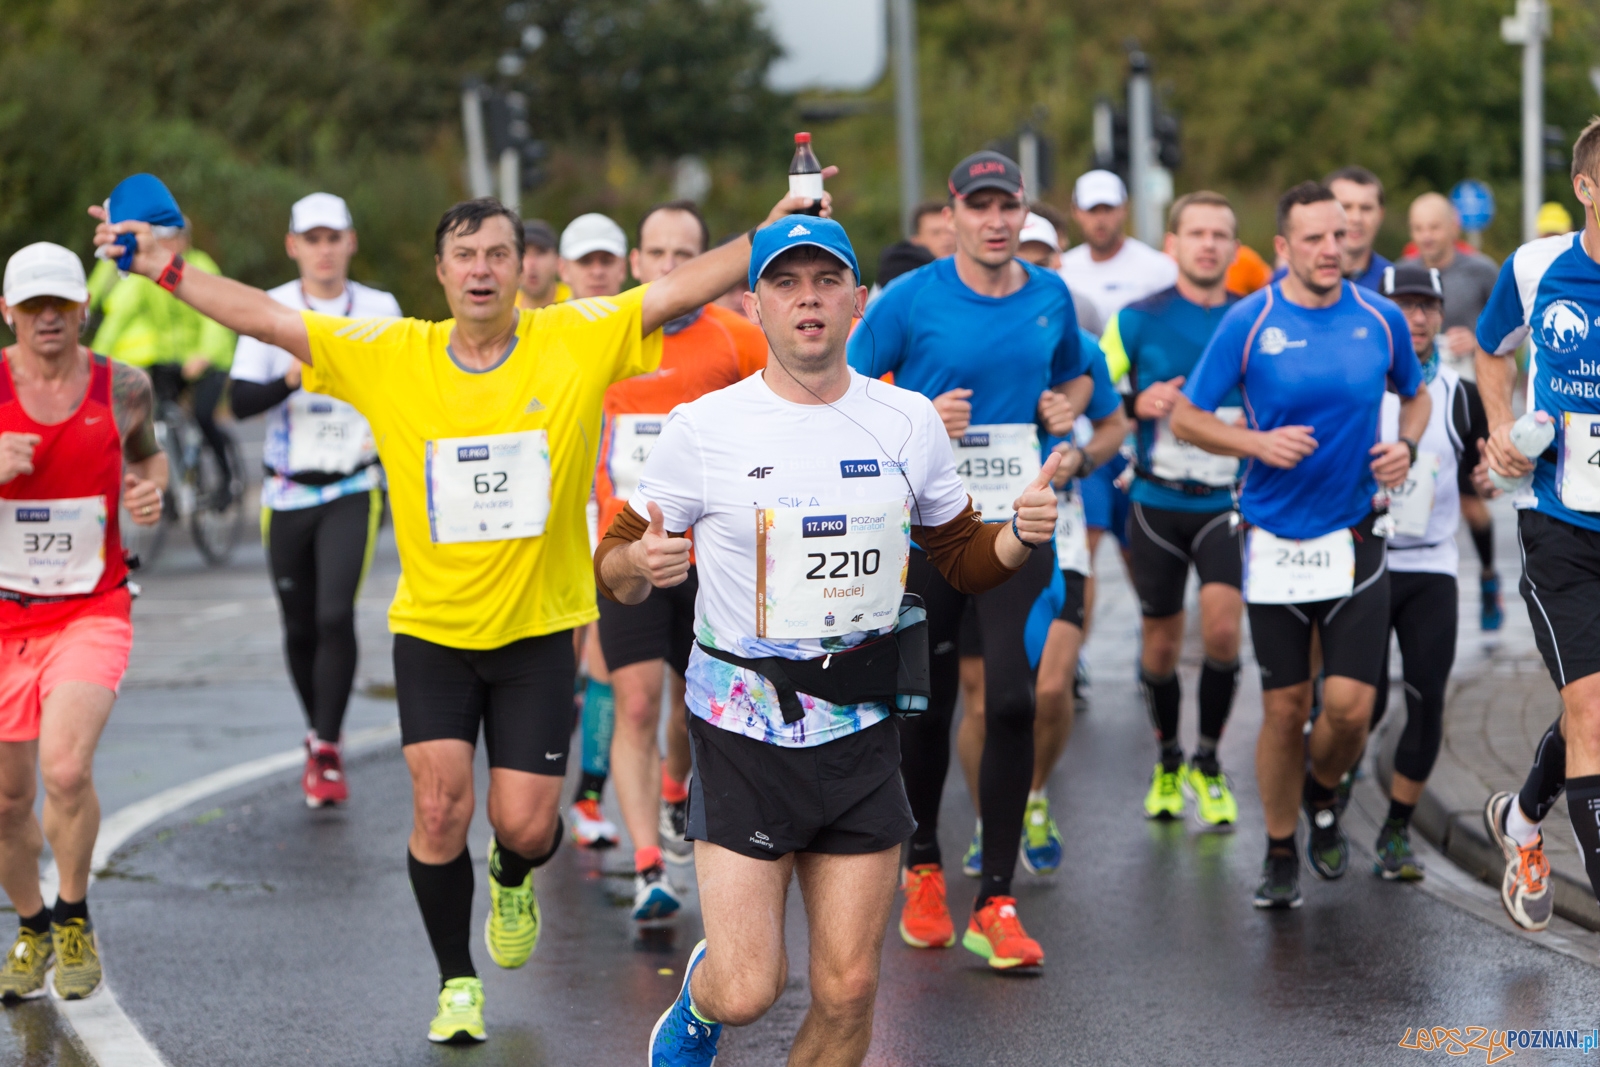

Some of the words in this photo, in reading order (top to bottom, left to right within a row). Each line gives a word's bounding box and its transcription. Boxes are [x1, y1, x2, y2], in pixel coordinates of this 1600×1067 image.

[748, 466, 774, 479] 4F
[956, 457, 1022, 477] 4396
[473, 471, 508, 494] 62
[473, 499, 514, 510] Andrzej
[850, 523, 885, 531] maraton
[24, 533, 72, 552] 373
[806, 548, 880, 579] 2210
[1276, 548, 1330, 567] 2441
[823, 584, 865, 599] Maciej
